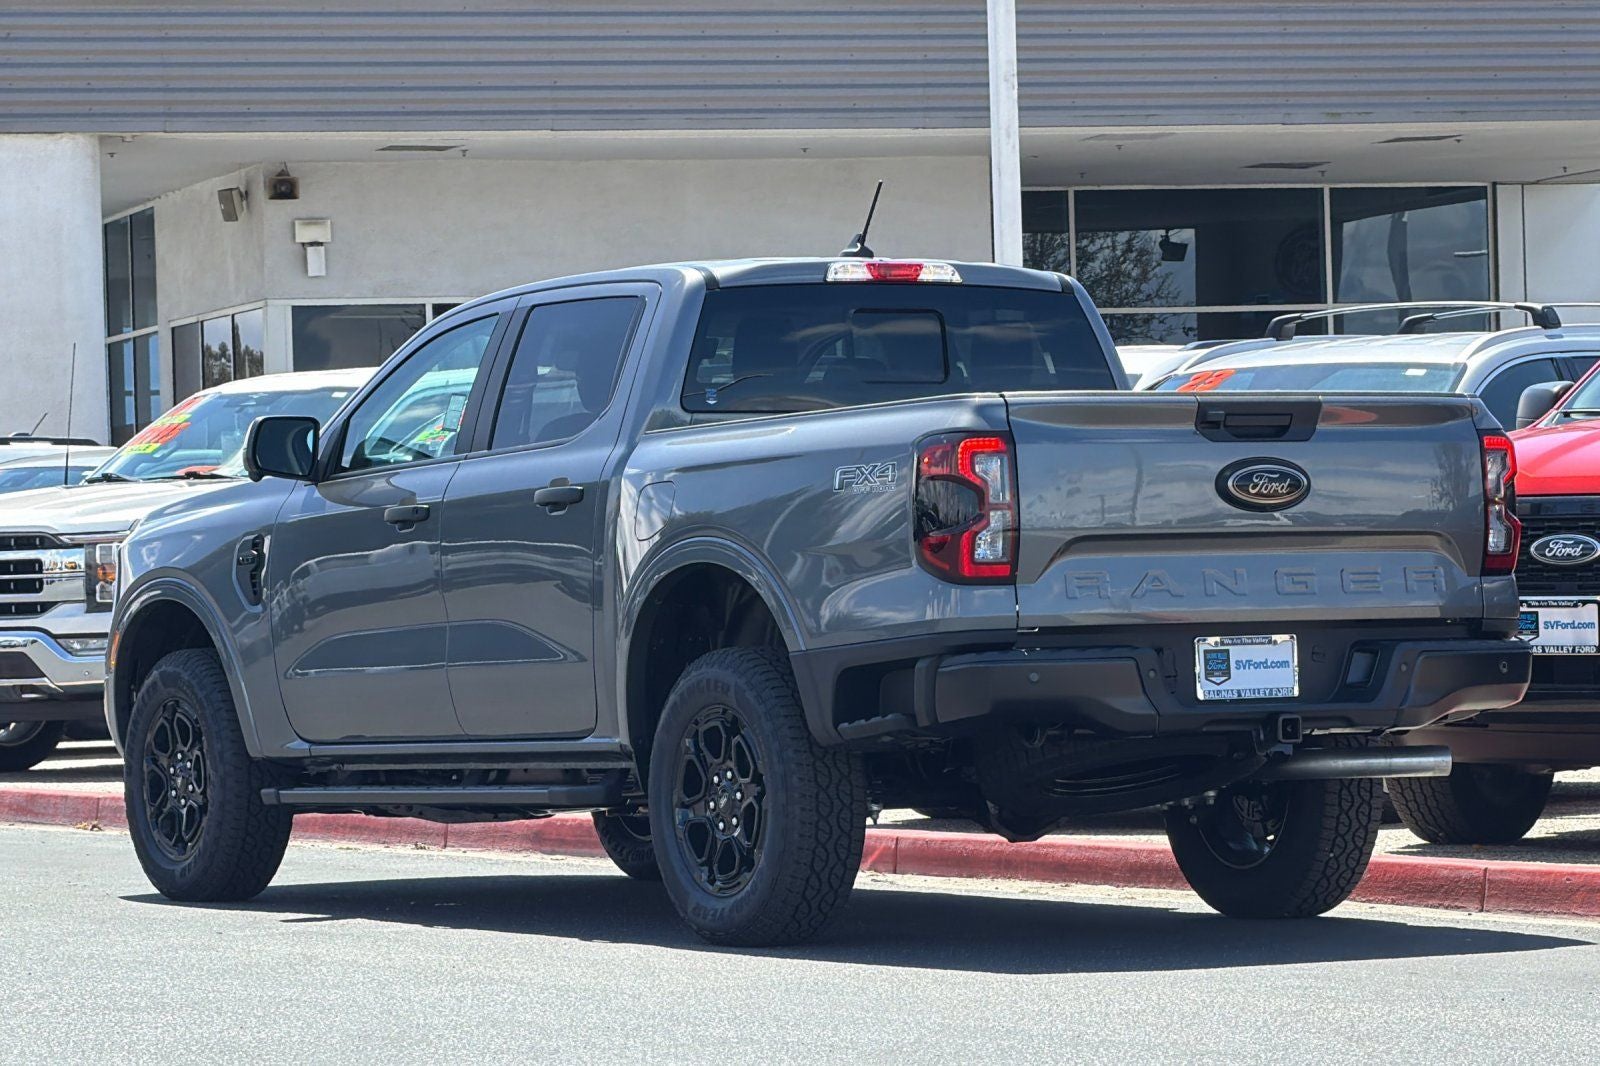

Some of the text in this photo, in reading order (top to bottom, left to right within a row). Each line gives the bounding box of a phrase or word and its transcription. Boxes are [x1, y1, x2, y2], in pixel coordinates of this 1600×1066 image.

[833, 462, 897, 492] FX4
[1248, 472, 1291, 494] Ford
[1545, 539, 1584, 557] Ford
[1064, 566, 1447, 600] RANGER
[1543, 620, 1596, 630] SVFord.com
[1234, 659, 1290, 670] SVFord.com
[1204, 687, 1294, 698] SALINAS VALLEY FORD
